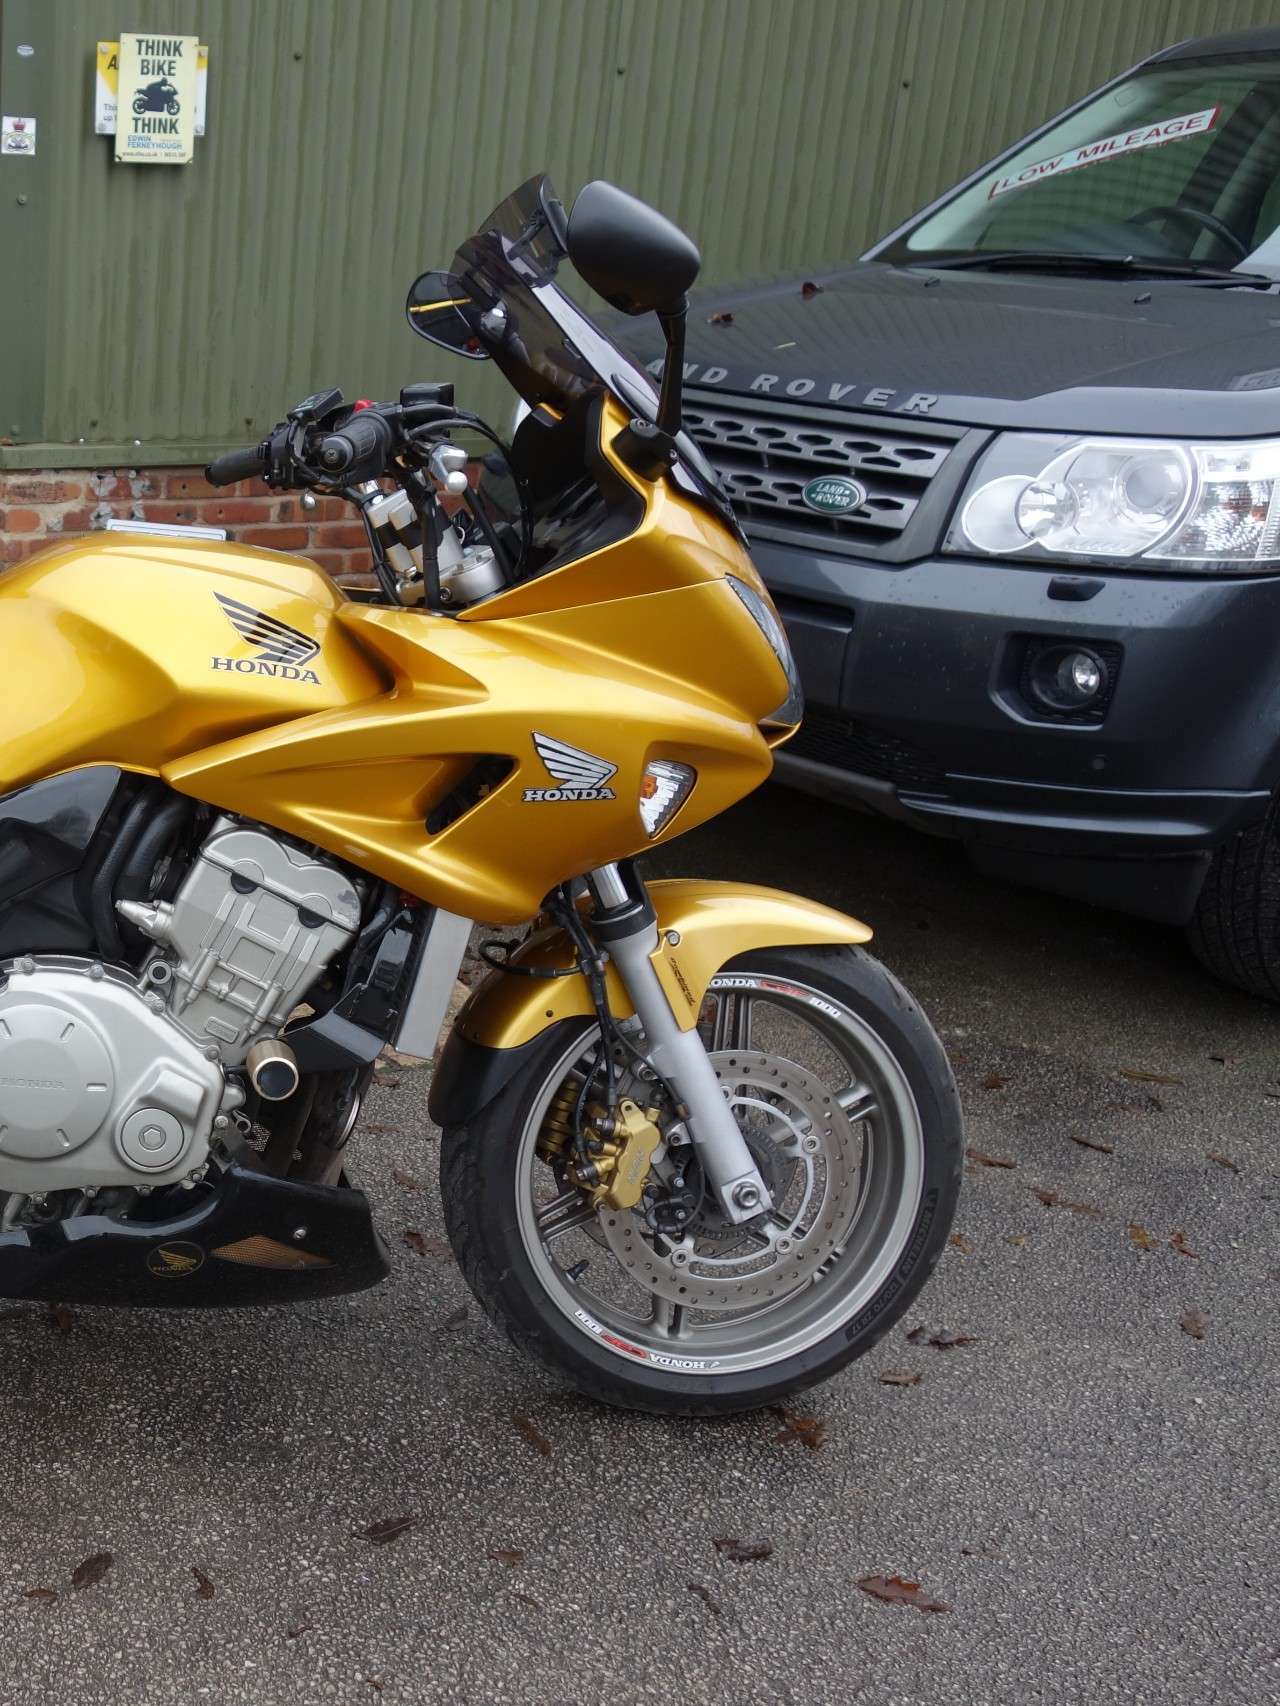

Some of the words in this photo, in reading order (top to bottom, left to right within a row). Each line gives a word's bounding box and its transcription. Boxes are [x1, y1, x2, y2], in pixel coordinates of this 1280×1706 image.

[136, 39, 183, 57] THINK
[140, 59, 176, 76] BIKE
[132, 118, 179, 134] THINK
[127, 142, 182, 150] FERNEYHOUGH
[1002, 157, 1064, 188] LOW
[1076, 114, 1206, 161] MILEAGE
[749, 373, 939, 414] ROVER
[816, 483, 845, 495] LAND
[815, 492, 850, 506] ROVER
[211, 656, 322, 685] HONDA
[523, 788, 616, 801] HONDA
[707, 978, 757, 988] ONDA
[808, 996, 842, 1019] 1000
[574, 1309, 603, 1335] 1000
[649, 1353, 705, 1369] HONDA
